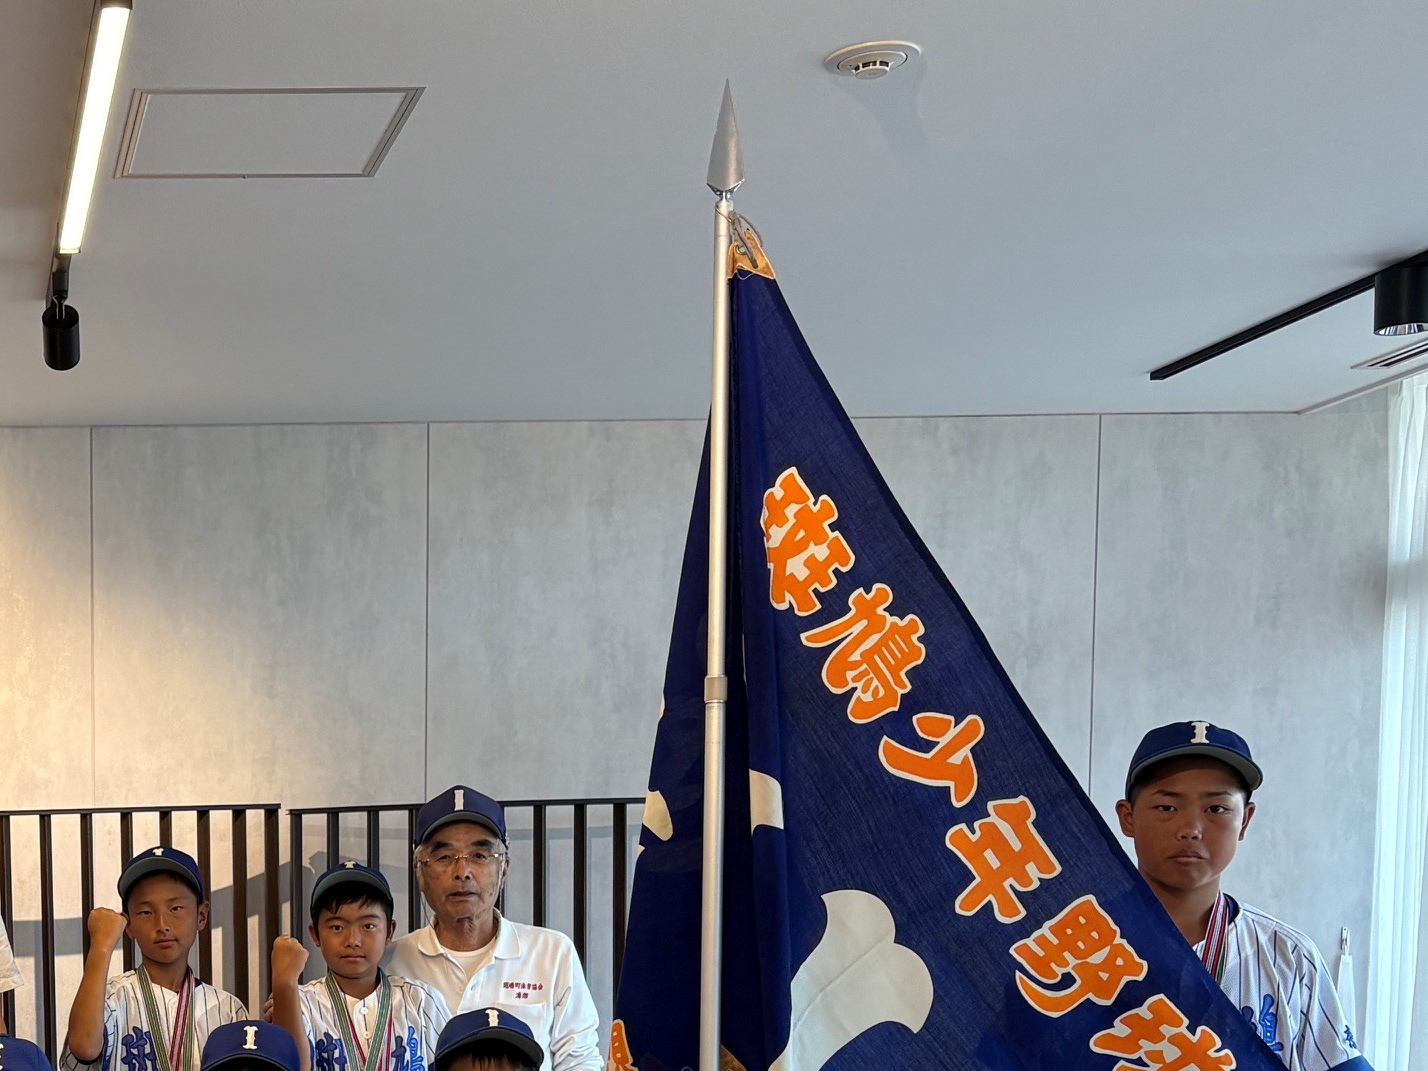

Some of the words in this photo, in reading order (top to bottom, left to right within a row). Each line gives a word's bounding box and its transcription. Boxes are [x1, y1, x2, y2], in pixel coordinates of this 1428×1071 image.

[1190, 721, 1210, 744] I
[454, 788, 464, 811] I
[485, 1008, 500, 1026] I
[242, 1025, 258, 1049] I
